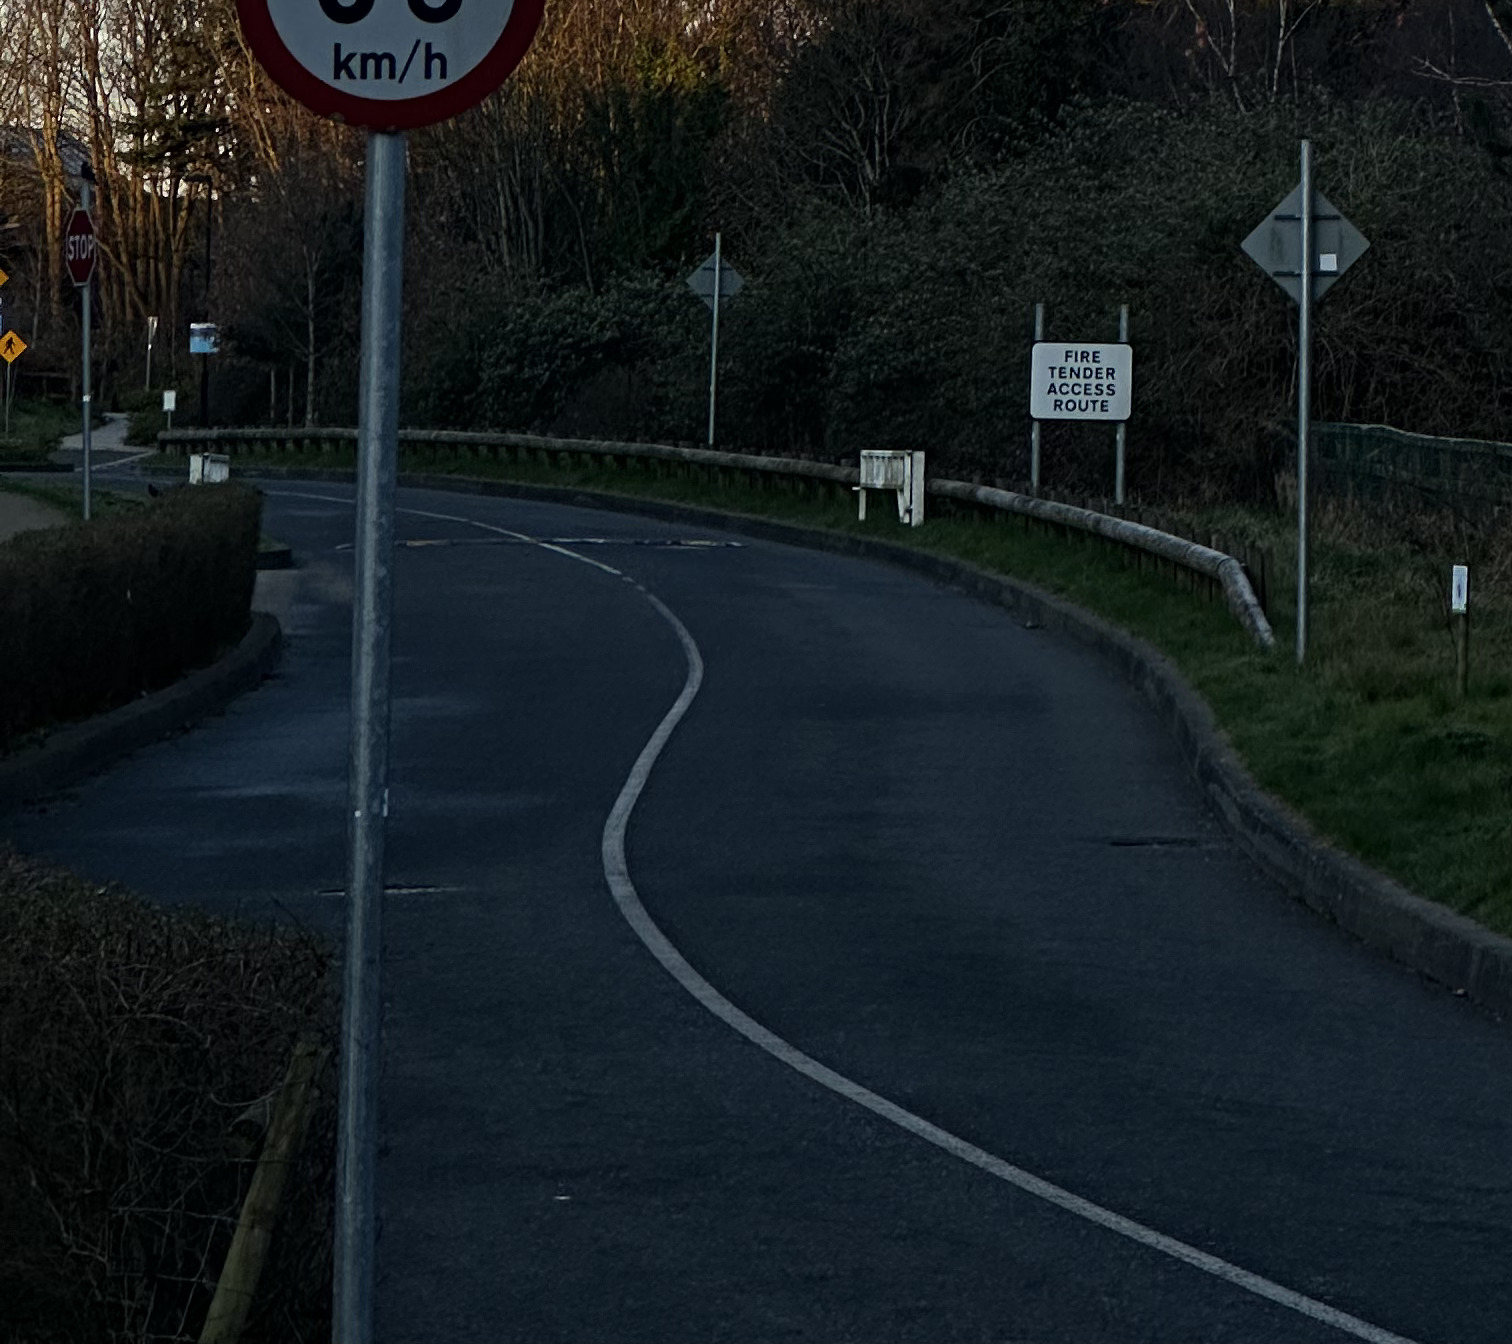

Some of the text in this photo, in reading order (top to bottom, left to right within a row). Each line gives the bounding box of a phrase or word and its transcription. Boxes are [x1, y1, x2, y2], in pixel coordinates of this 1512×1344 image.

[333, 39, 447, 83] km/h
[68, 234, 93, 261] STOP
[1064, 350, 1101, 363] FIRE
[1048, 366, 1116, 380] TENDER
[1047, 382, 1116, 396] ACCESS
[1053, 399, 1109, 412] ROUTE
